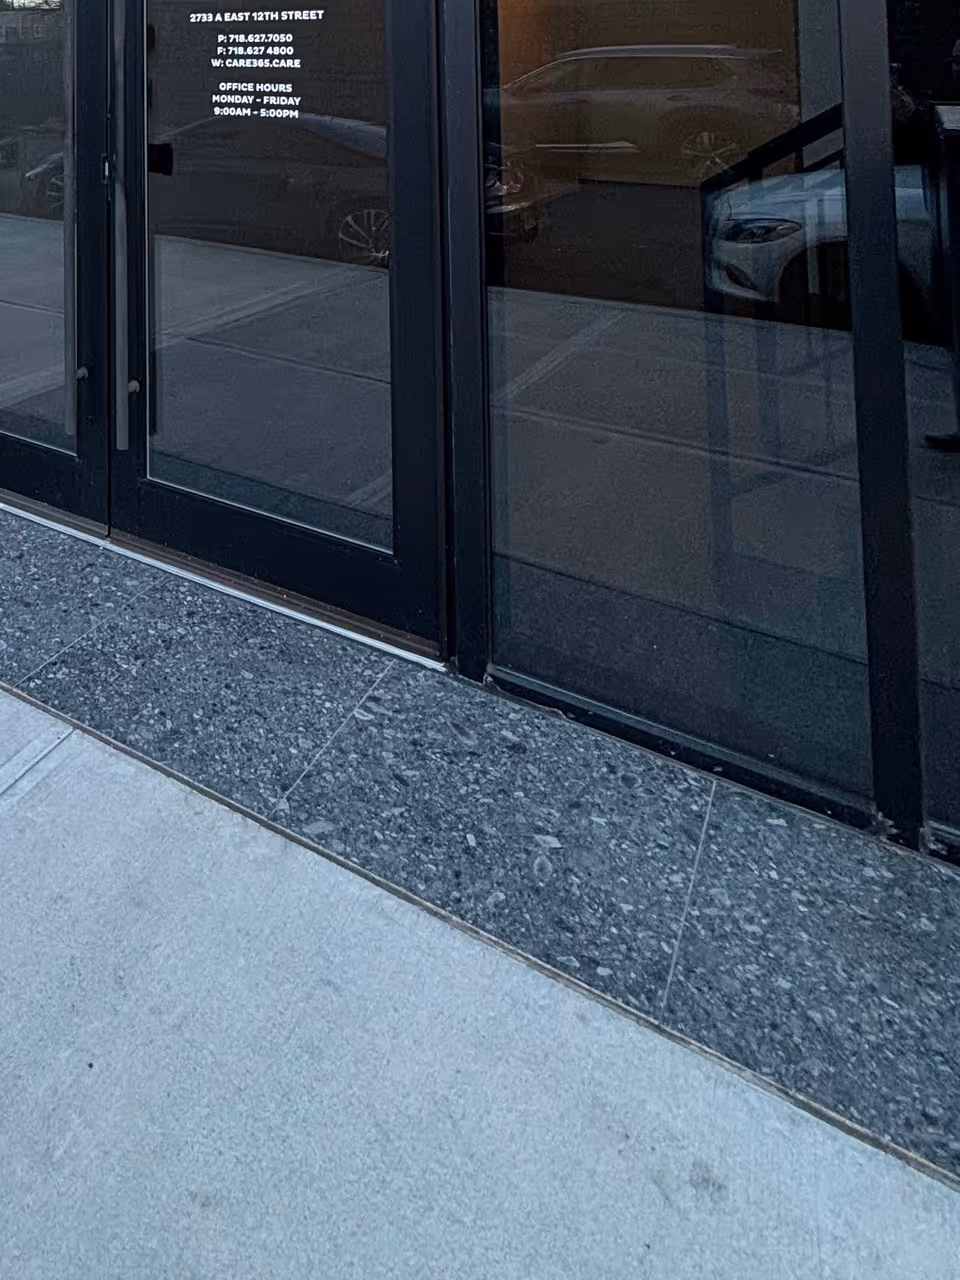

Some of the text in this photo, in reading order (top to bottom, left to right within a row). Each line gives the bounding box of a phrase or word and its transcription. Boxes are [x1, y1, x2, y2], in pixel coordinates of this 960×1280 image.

[190, 10, 324, 22] 2733 A EAST 12TH STREET
[217, 33, 293, 43] P: 718.627.7050
[217, 46, 226, 55] F:
[211, 59, 301, 68] W: CARE365.CARE
[219, 82, 293, 93] OFFICE HOURS
[212, 94, 254, 104] MONDAY
[263, 96, 301, 106] FRIDAY
[213, 107, 251, 116] 9:00AM
[260, 108, 299, 118] 5:00PM
